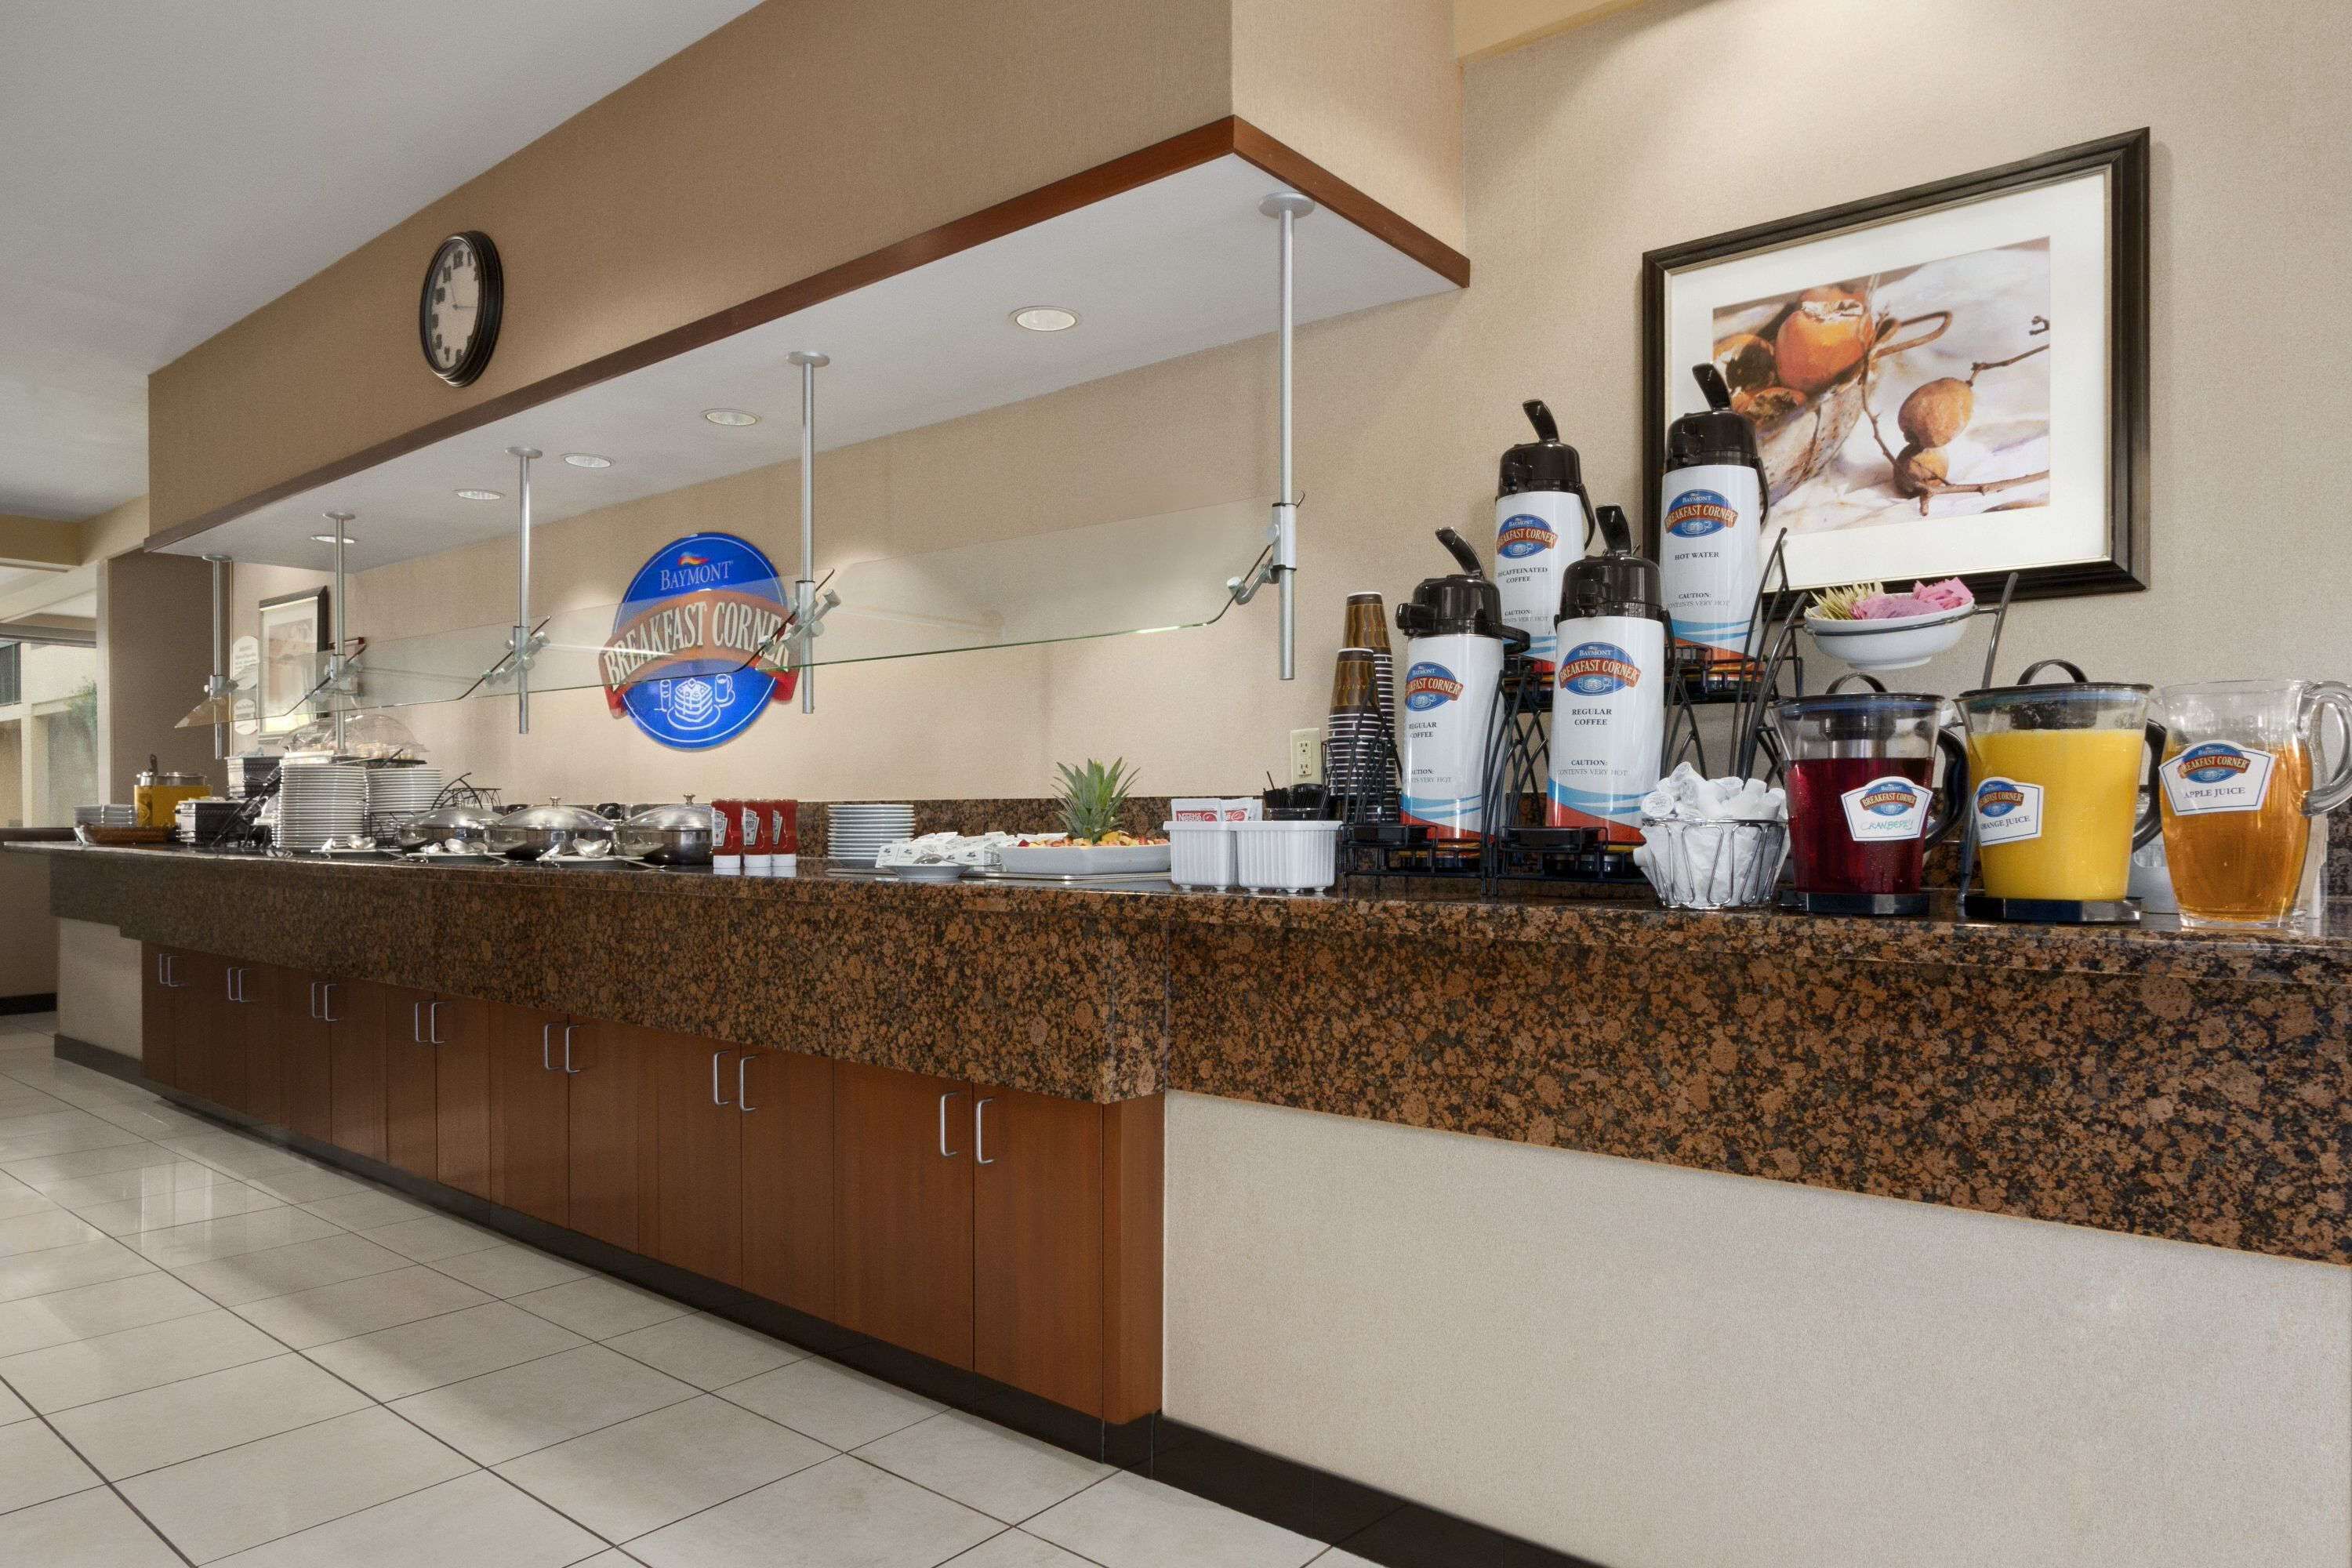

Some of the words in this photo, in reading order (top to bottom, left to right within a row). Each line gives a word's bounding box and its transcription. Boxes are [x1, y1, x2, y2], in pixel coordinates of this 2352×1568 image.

[1665, 505, 1702, 527] BREAKFAST
[1703, 505, 1737, 524] CORNER
[1526, 528, 1556, 543] CORNER
[660, 561, 731, 590] BAYMONT
[604, 601, 707, 693] BREAKFAST
[1559, 659, 1600, 682] BREAKFAST
[1602, 660, 1638, 681] CORNER
[1428, 677, 1460, 695] CORNER
[2180, 756, 2216, 773] BREAKFAST
[2217, 756, 2247, 768] CORNER
[1862, 793, 1895, 807] BREAKFAST
[2183, 789, 2212, 799] APPLE
[2213, 787, 2246, 797] JUICE
[2005, 816, 2031, 827] JUICE
